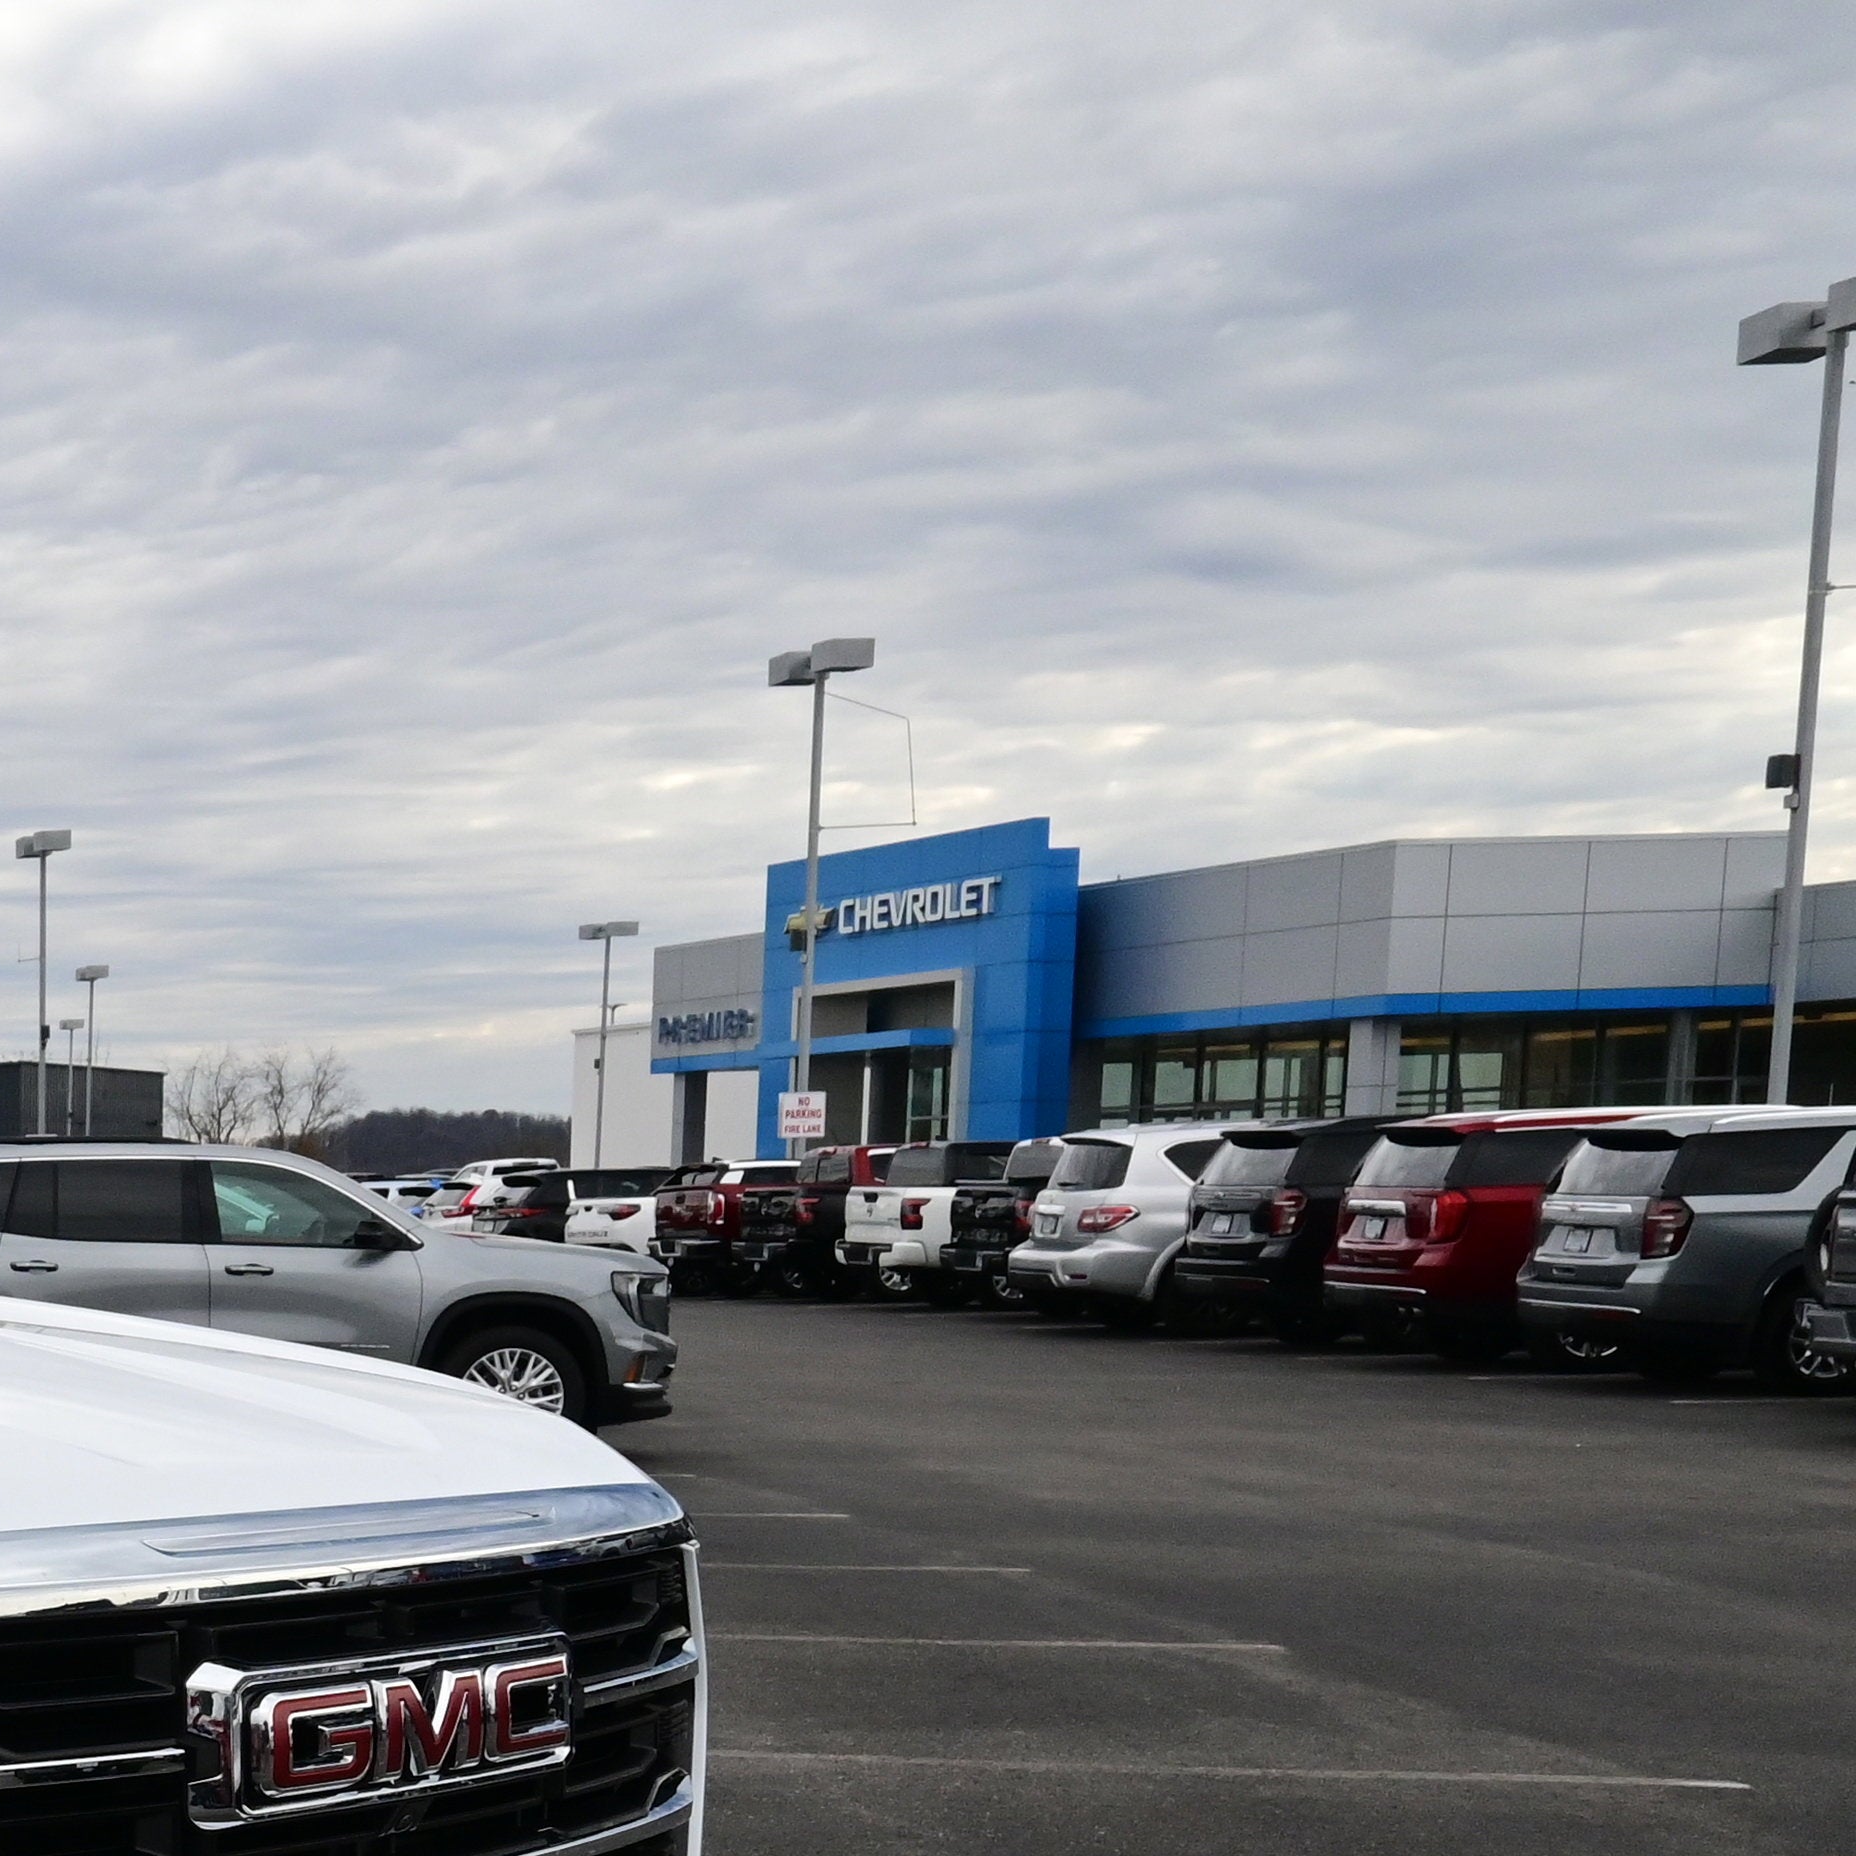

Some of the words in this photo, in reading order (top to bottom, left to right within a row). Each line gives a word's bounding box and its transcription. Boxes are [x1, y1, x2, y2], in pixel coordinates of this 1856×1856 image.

[839, 876, 999, 934] CHEVROLET
[798, 1096, 811, 1106] NO
[785, 1109, 822, 1119] PARKING
[784, 1125, 800, 1134] FIRE
[803, 1124, 821, 1133] LANE
[250, 1653, 572, 1798] GMC
